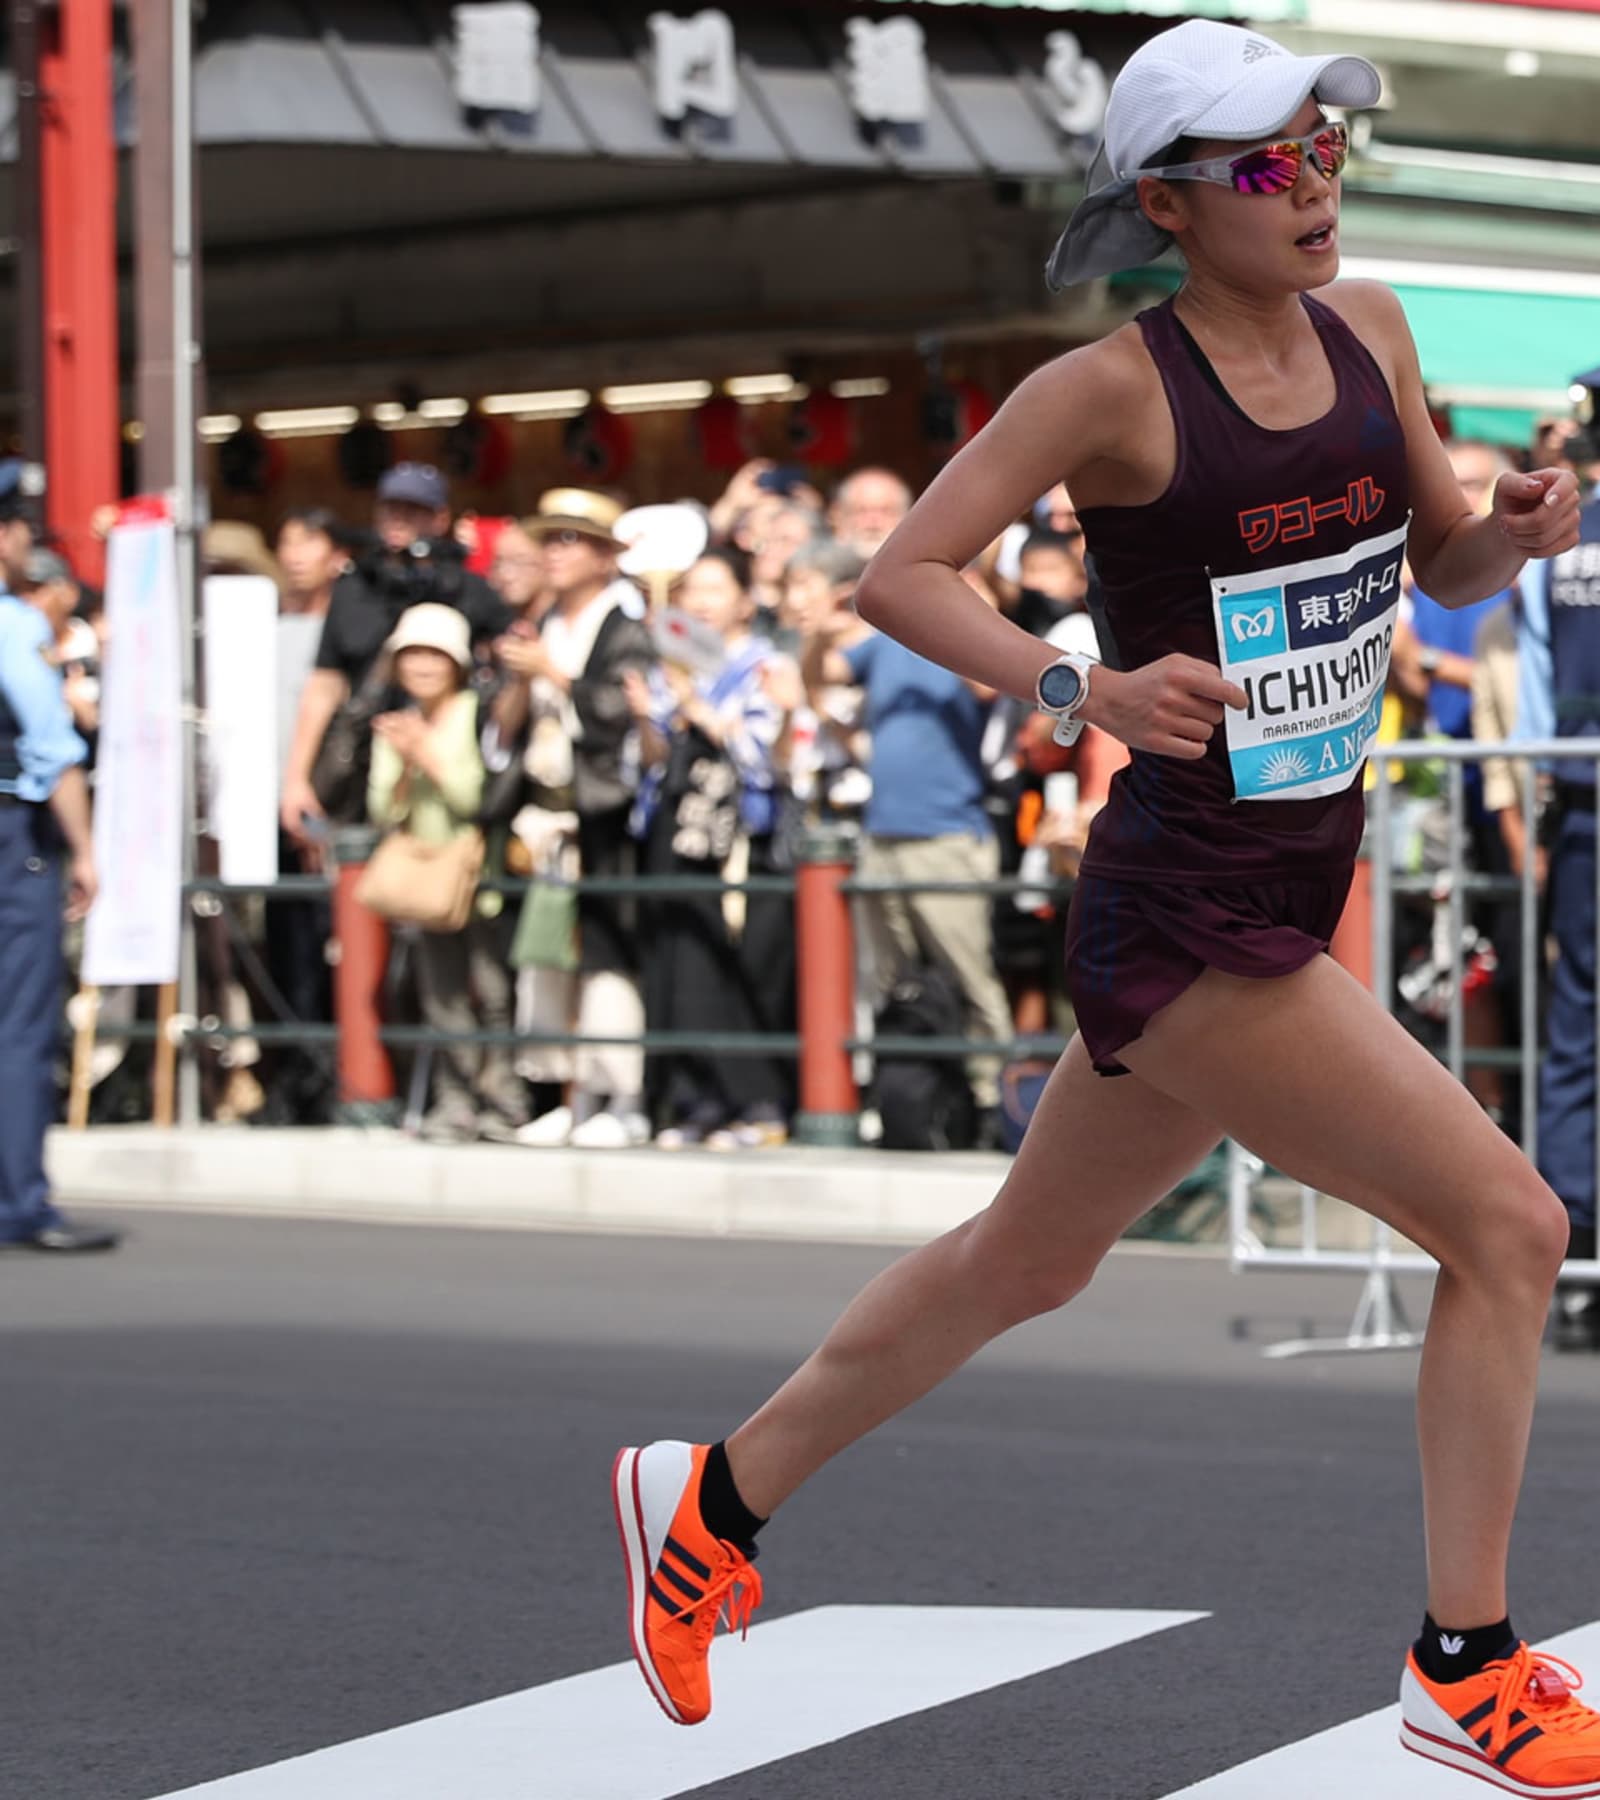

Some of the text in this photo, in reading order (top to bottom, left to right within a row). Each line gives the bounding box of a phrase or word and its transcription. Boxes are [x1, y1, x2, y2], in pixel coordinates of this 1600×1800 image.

[1238, 476, 1385, 554] ワコール
[1298, 561, 1398, 631] 東京メトロ
[1263, 716, 1327, 740] MARATHON
